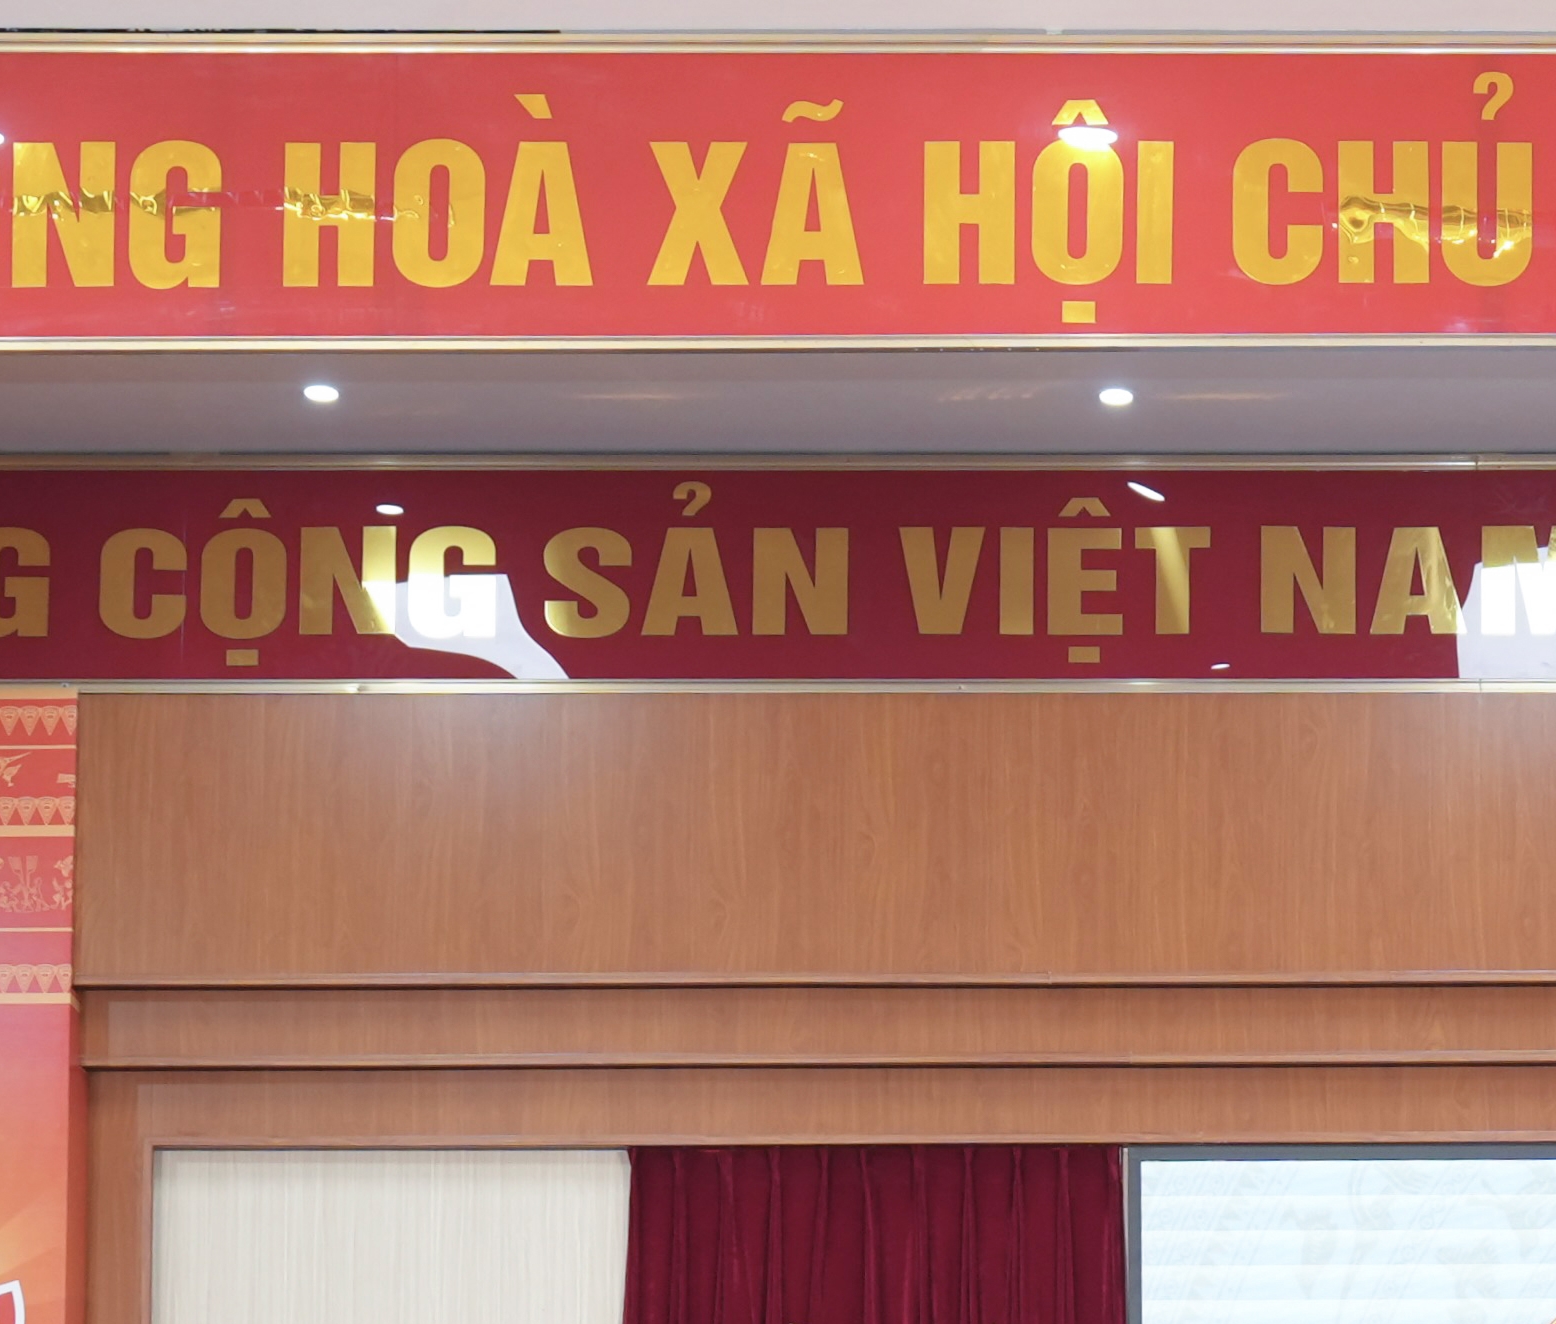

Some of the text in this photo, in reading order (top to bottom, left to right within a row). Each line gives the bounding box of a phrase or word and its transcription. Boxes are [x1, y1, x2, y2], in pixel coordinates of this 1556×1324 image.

[277, 90, 599, 296] HOÀ
[642, 95, 870, 295] XÃ
[917, 98, 1179, 328] HỘI
[1226, 70, 1540, 292] CHỦ
[94, 495, 502, 670] CỘNG
[542, 480, 853, 640] SẢN
[894, 495, 1219, 668] VIỆT
